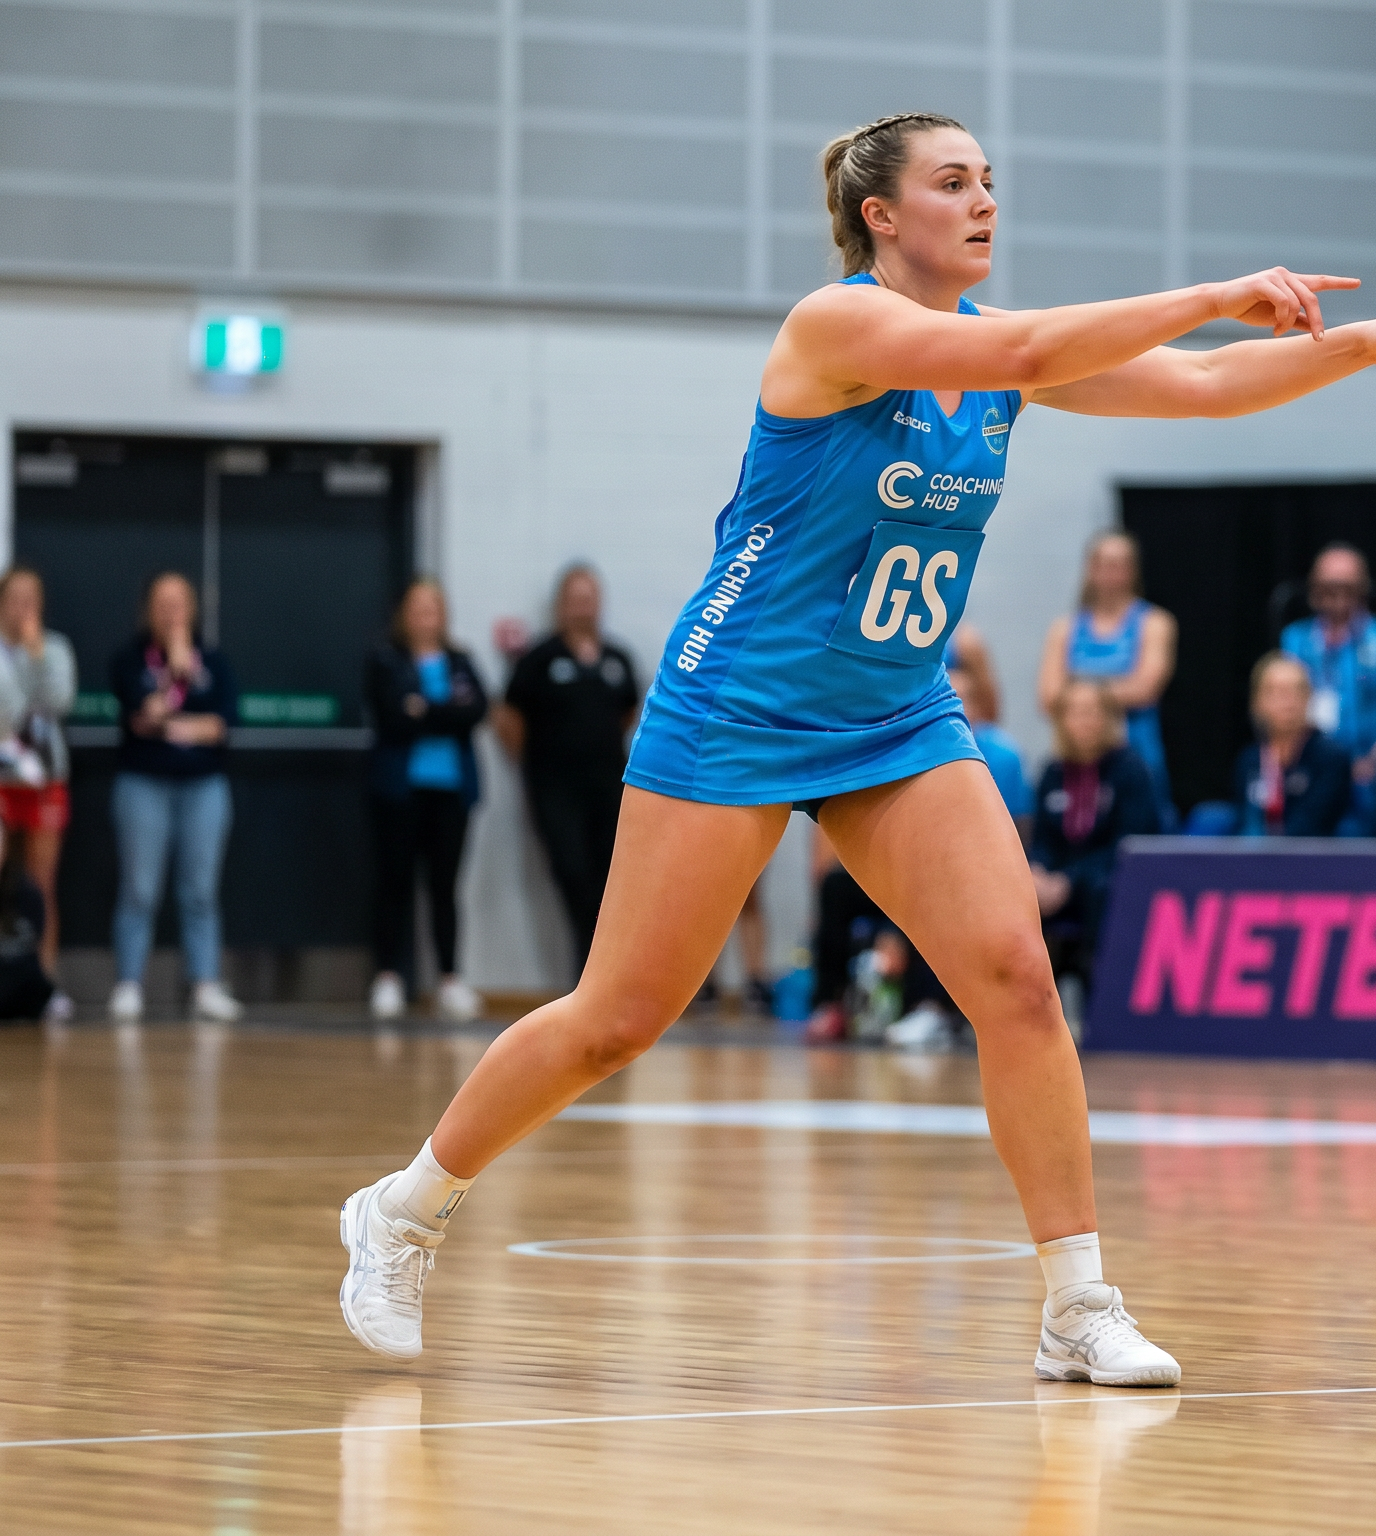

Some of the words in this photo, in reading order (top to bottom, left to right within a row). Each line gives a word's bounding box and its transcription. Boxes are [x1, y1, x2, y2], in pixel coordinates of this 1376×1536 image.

[921, 492, 960, 511] HUB
[929, 473, 1004, 496] COACHING
[701, 523, 774, 625] COACHING
[860, 545, 958, 648] GS
[677, 625, 714, 673] HUB
